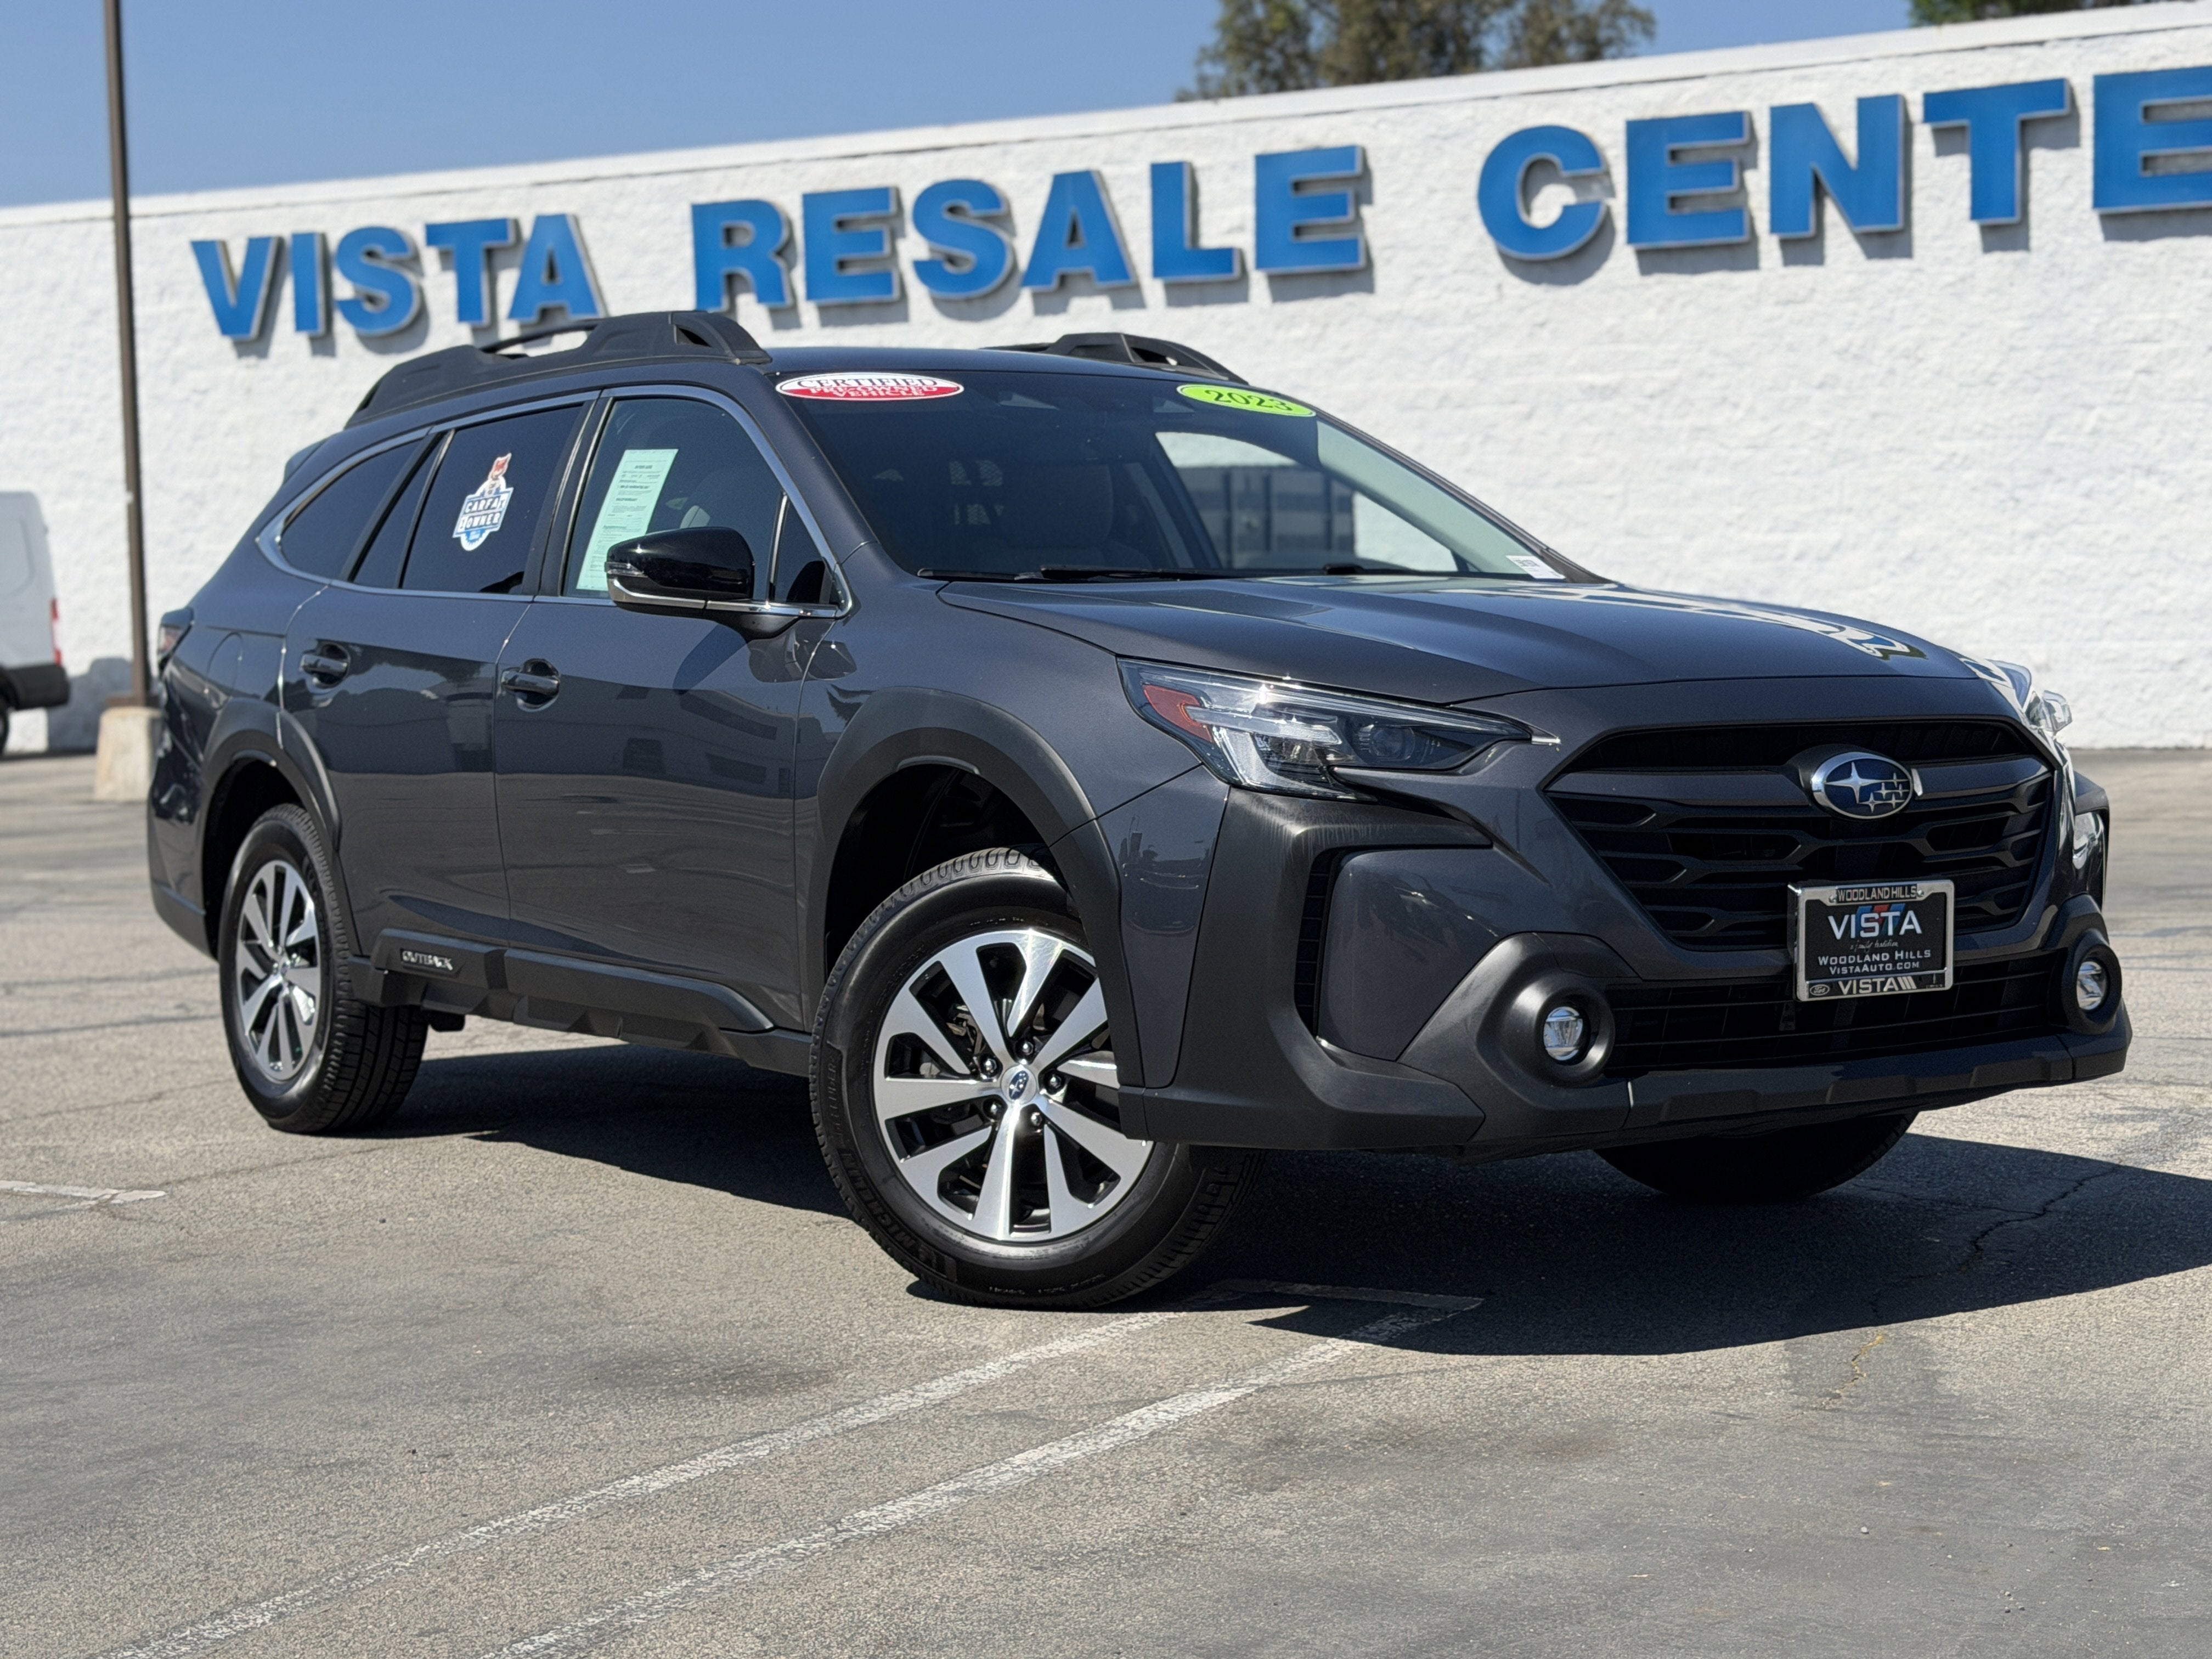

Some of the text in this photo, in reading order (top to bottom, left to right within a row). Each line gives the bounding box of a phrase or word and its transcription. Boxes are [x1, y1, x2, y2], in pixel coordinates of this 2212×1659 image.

[190, 213, 604, 340] VISTA
[691, 145, 1366, 312] RESALE
[797, 378, 938, 388] CERTIFIED
[1204, 390, 1293, 411] 2023
[465, 496, 505, 513] CARFAX
[1838, 885, 1916, 902] WOODLAND HILLS
[1827, 910, 1922, 940] VISTA
[1838, 977, 1899, 995] VISTA
